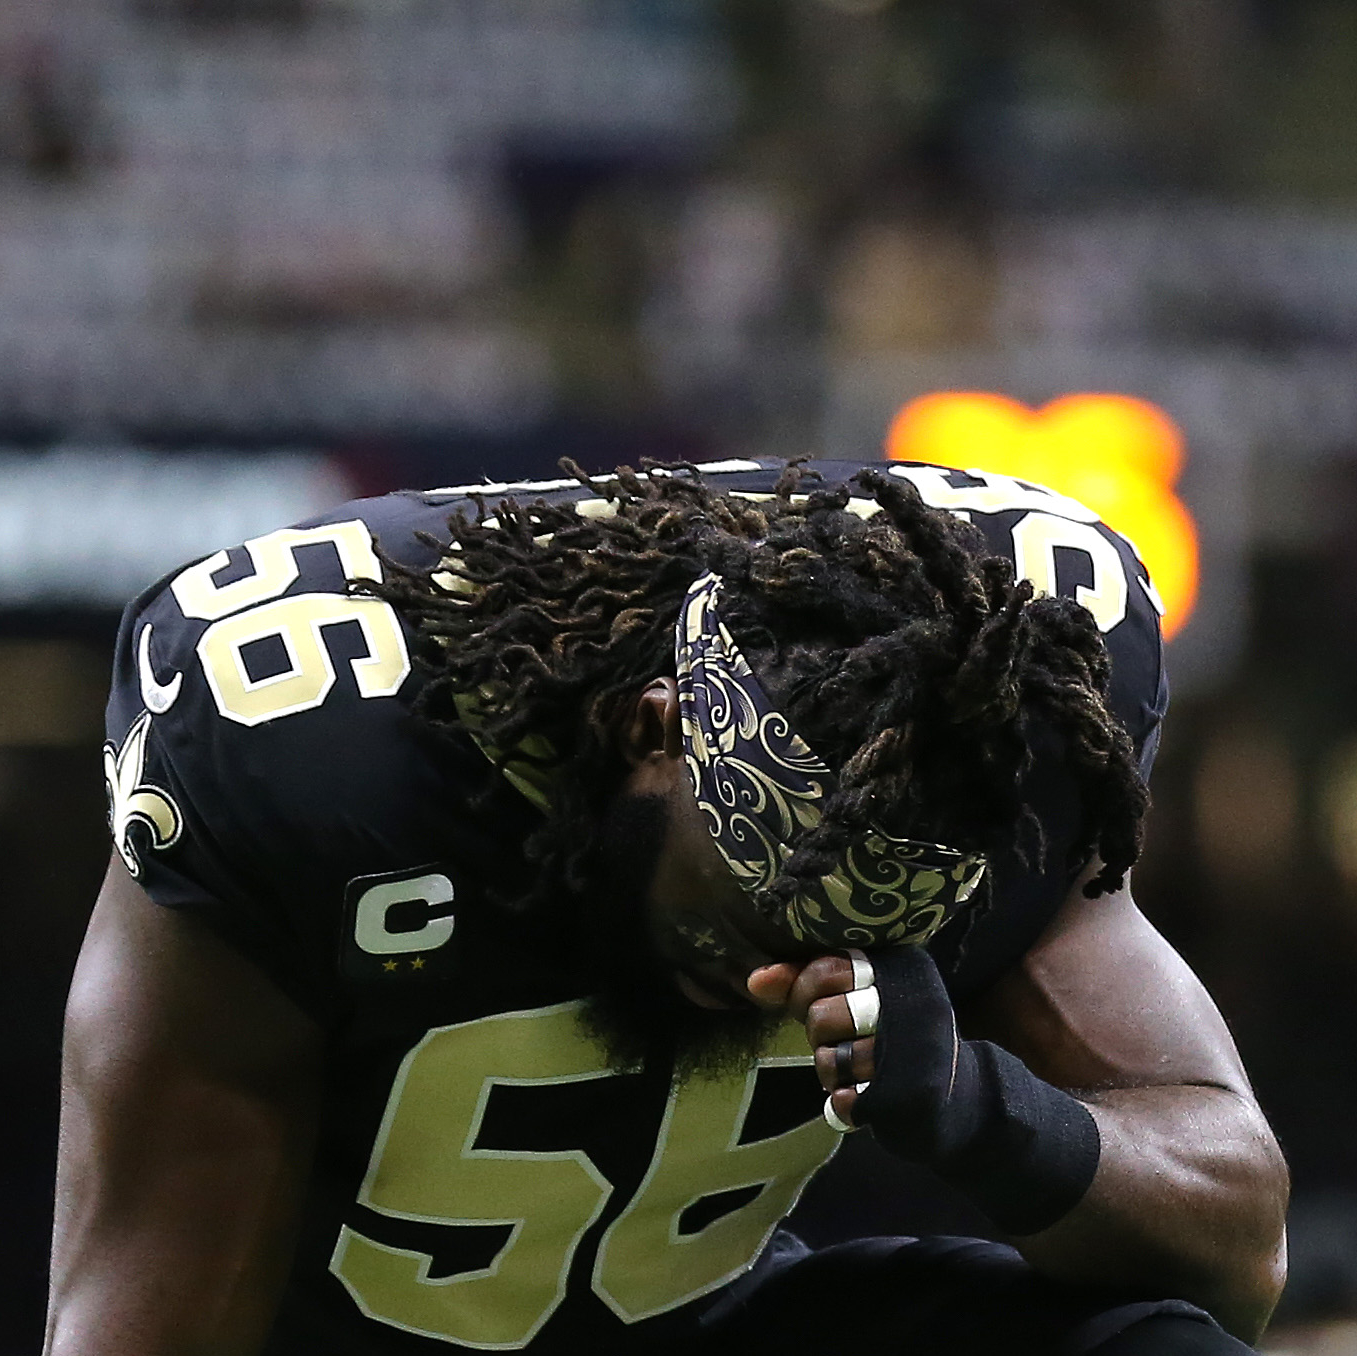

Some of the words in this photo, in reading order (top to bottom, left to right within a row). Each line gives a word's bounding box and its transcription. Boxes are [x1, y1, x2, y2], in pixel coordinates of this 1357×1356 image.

[169, 518, 411, 727] 56
[354, 873, 455, 955] C
[328, 1000, 844, 1351] 56
